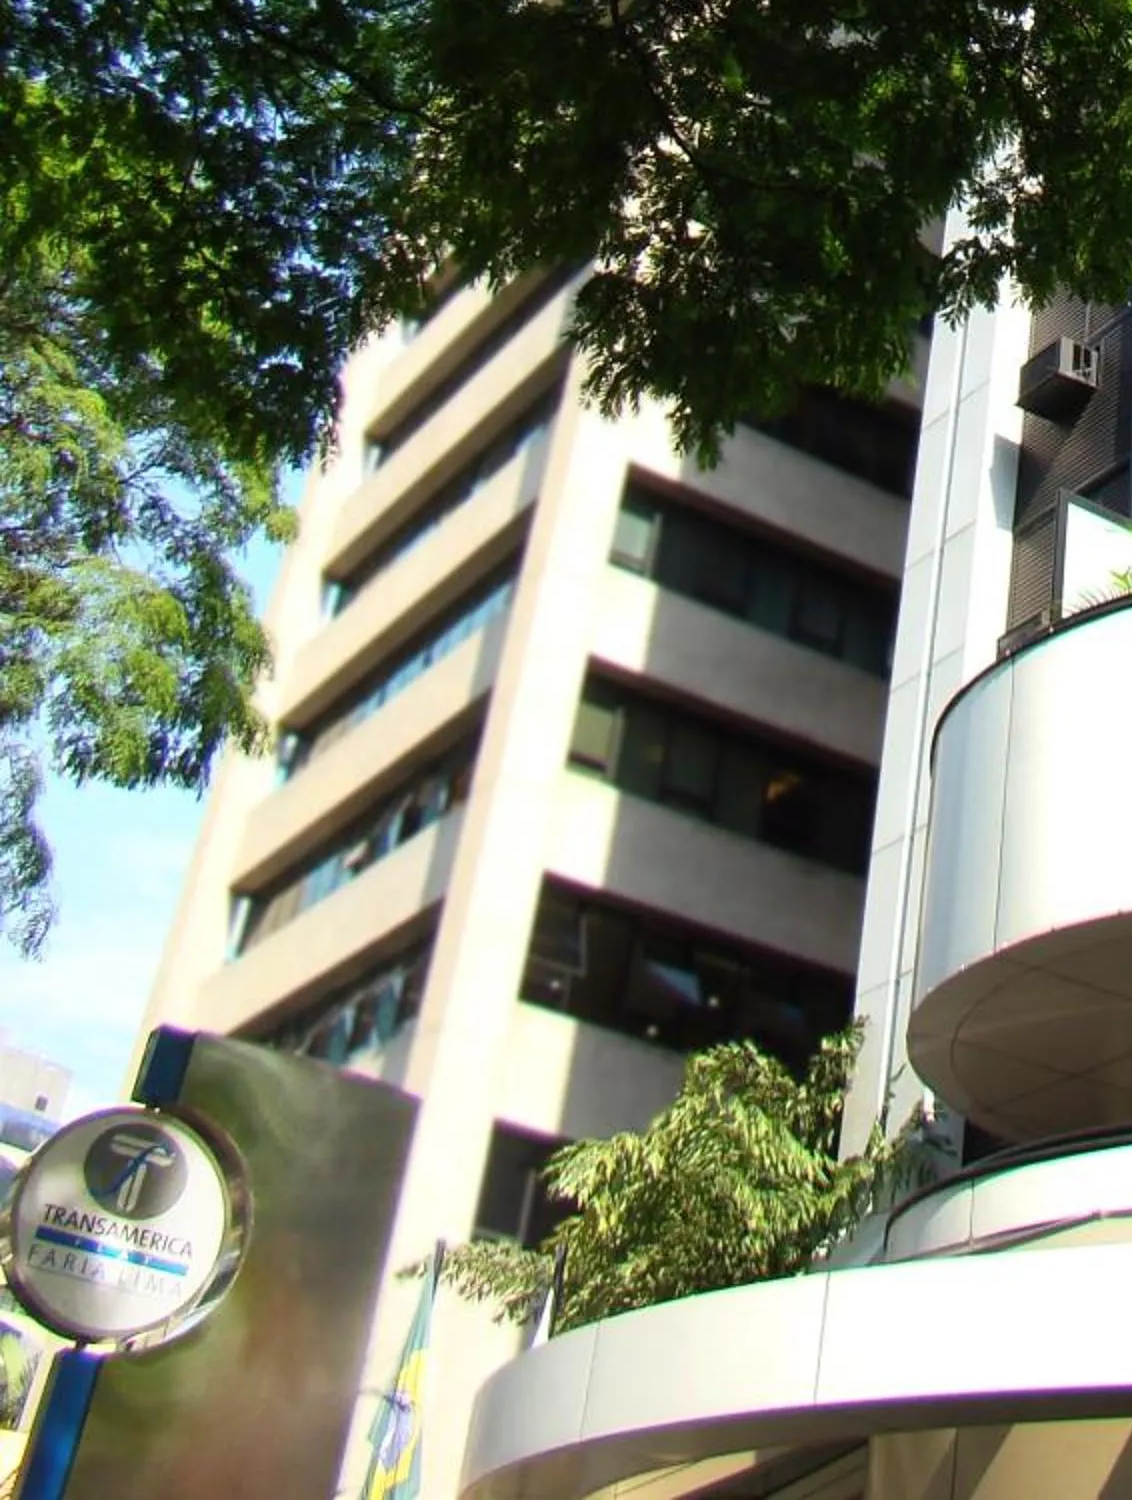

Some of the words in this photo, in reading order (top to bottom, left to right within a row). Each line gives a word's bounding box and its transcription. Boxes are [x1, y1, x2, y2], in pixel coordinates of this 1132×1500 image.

[44, 1203, 193, 1258] TRANSAMERICA
[27, 1243, 106, 1280] FARIA
[117, 1266, 183, 1299] LIMA
